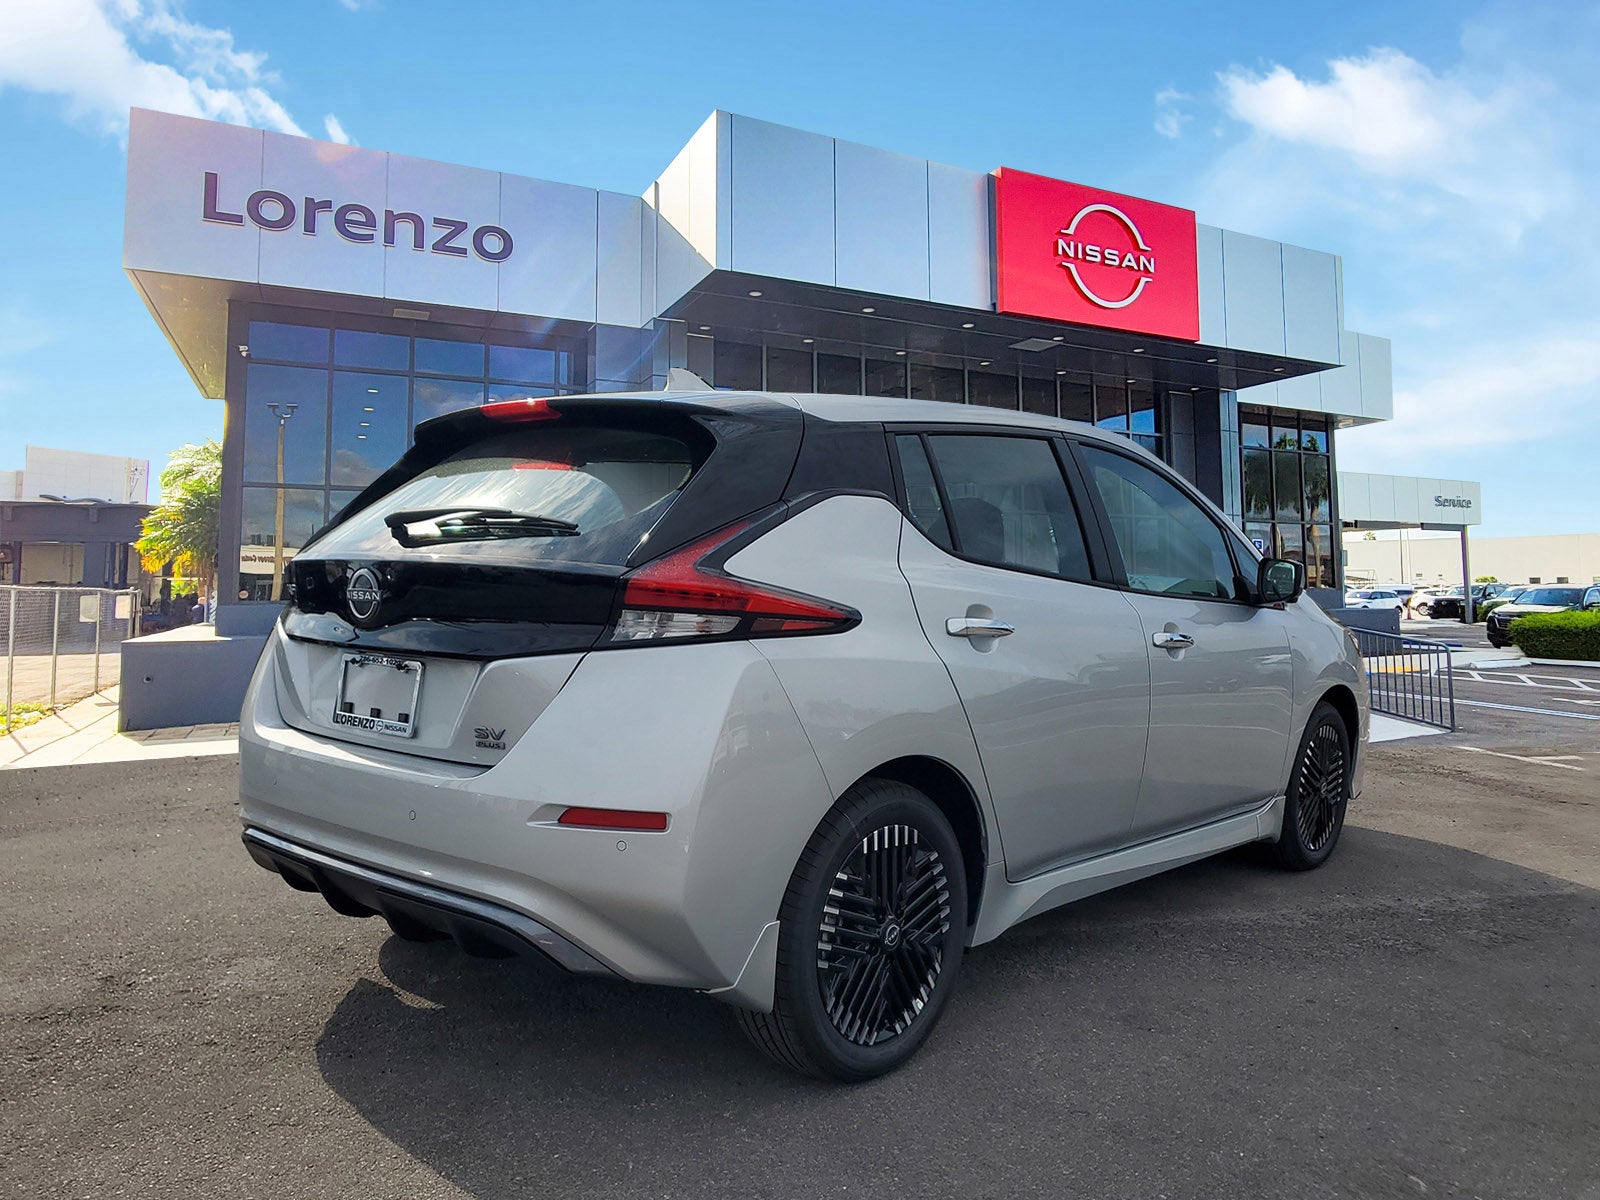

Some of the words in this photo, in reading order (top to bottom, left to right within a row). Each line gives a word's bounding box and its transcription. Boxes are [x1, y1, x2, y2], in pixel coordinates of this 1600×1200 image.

[202, 171, 514, 262] Lorenzo
[1057, 238, 1155, 273] NISSAN
[1434, 495, 1472, 508] Service
[336, 713, 375, 730] LORENZO
[384, 724, 407, 733] NISSAN
[474, 727, 506, 741] SV
[476, 740, 505, 750] PLUS
